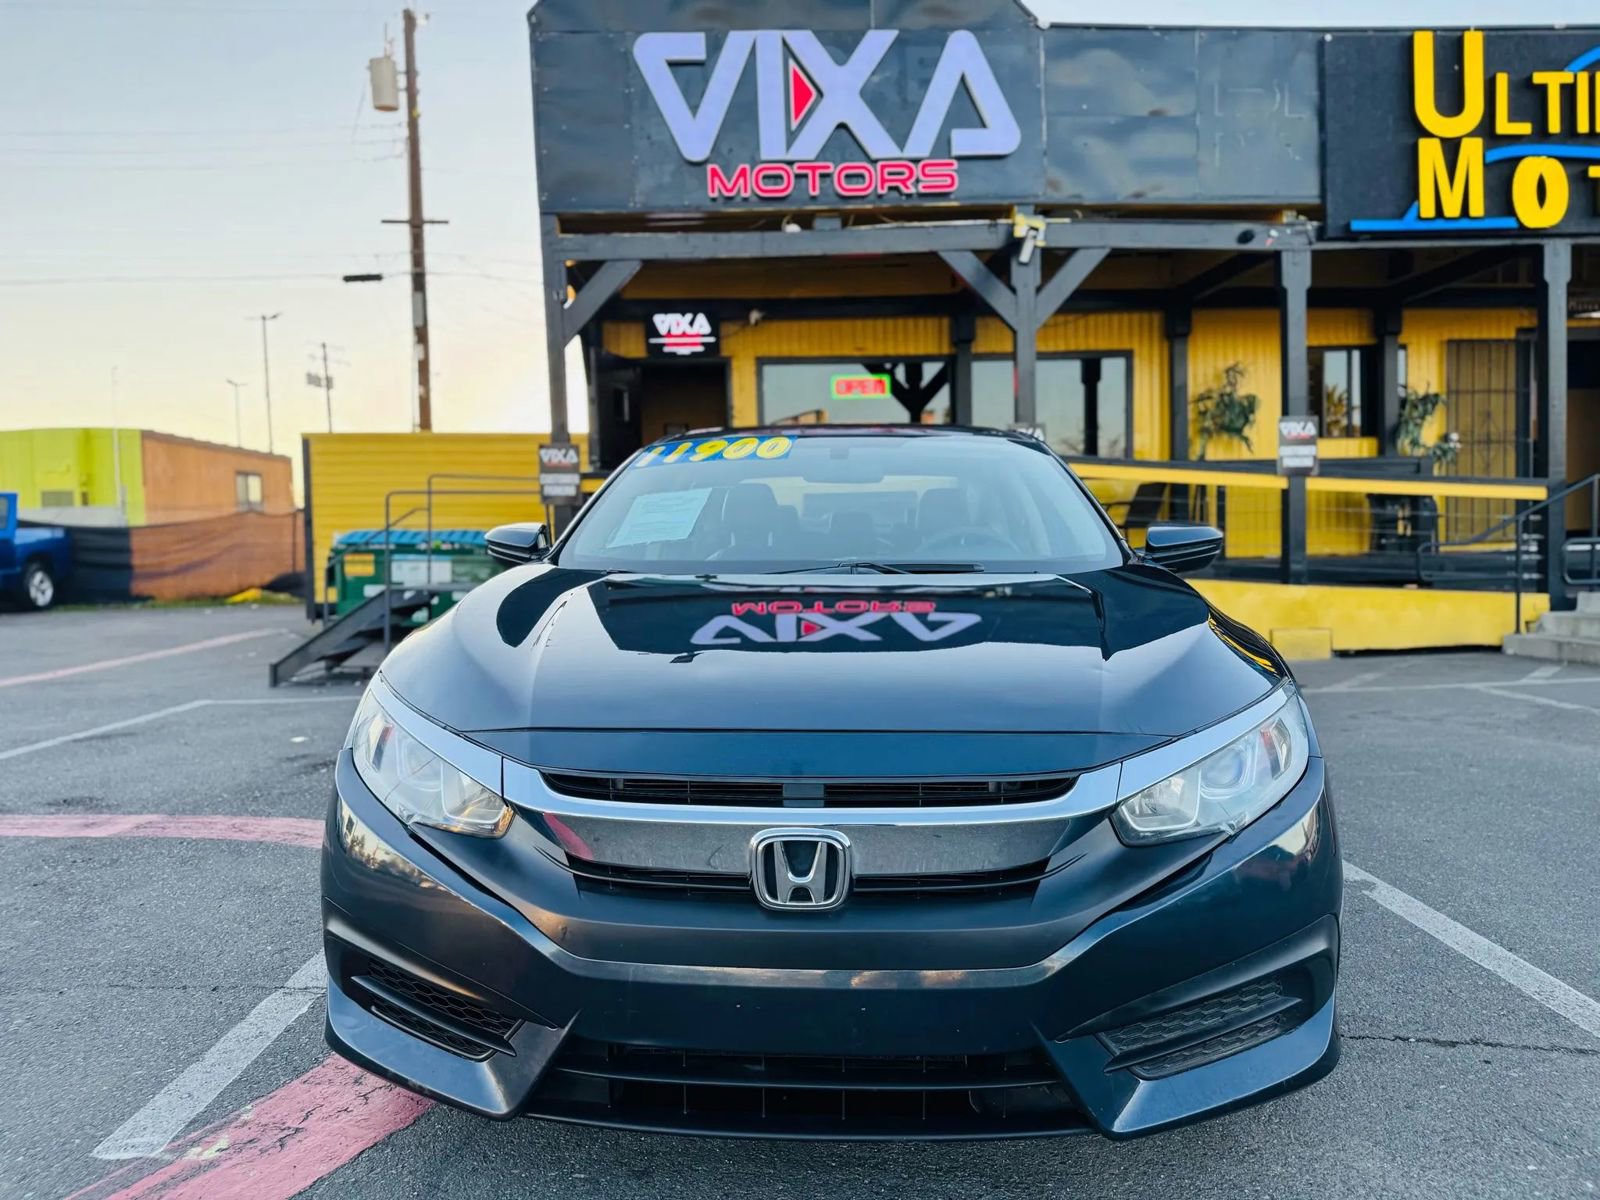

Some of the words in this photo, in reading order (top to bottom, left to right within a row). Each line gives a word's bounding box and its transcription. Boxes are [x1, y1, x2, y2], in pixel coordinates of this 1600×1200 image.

[633, 29, 1021, 163] VIXA
[1413, 30, 1600, 138] ULTI
[706, 160, 959, 198] MOTORS
[1418, 137, 1600, 228] MO
[835, 378, 886, 396] OPEN
[635, 436, 793, 468] 11900
